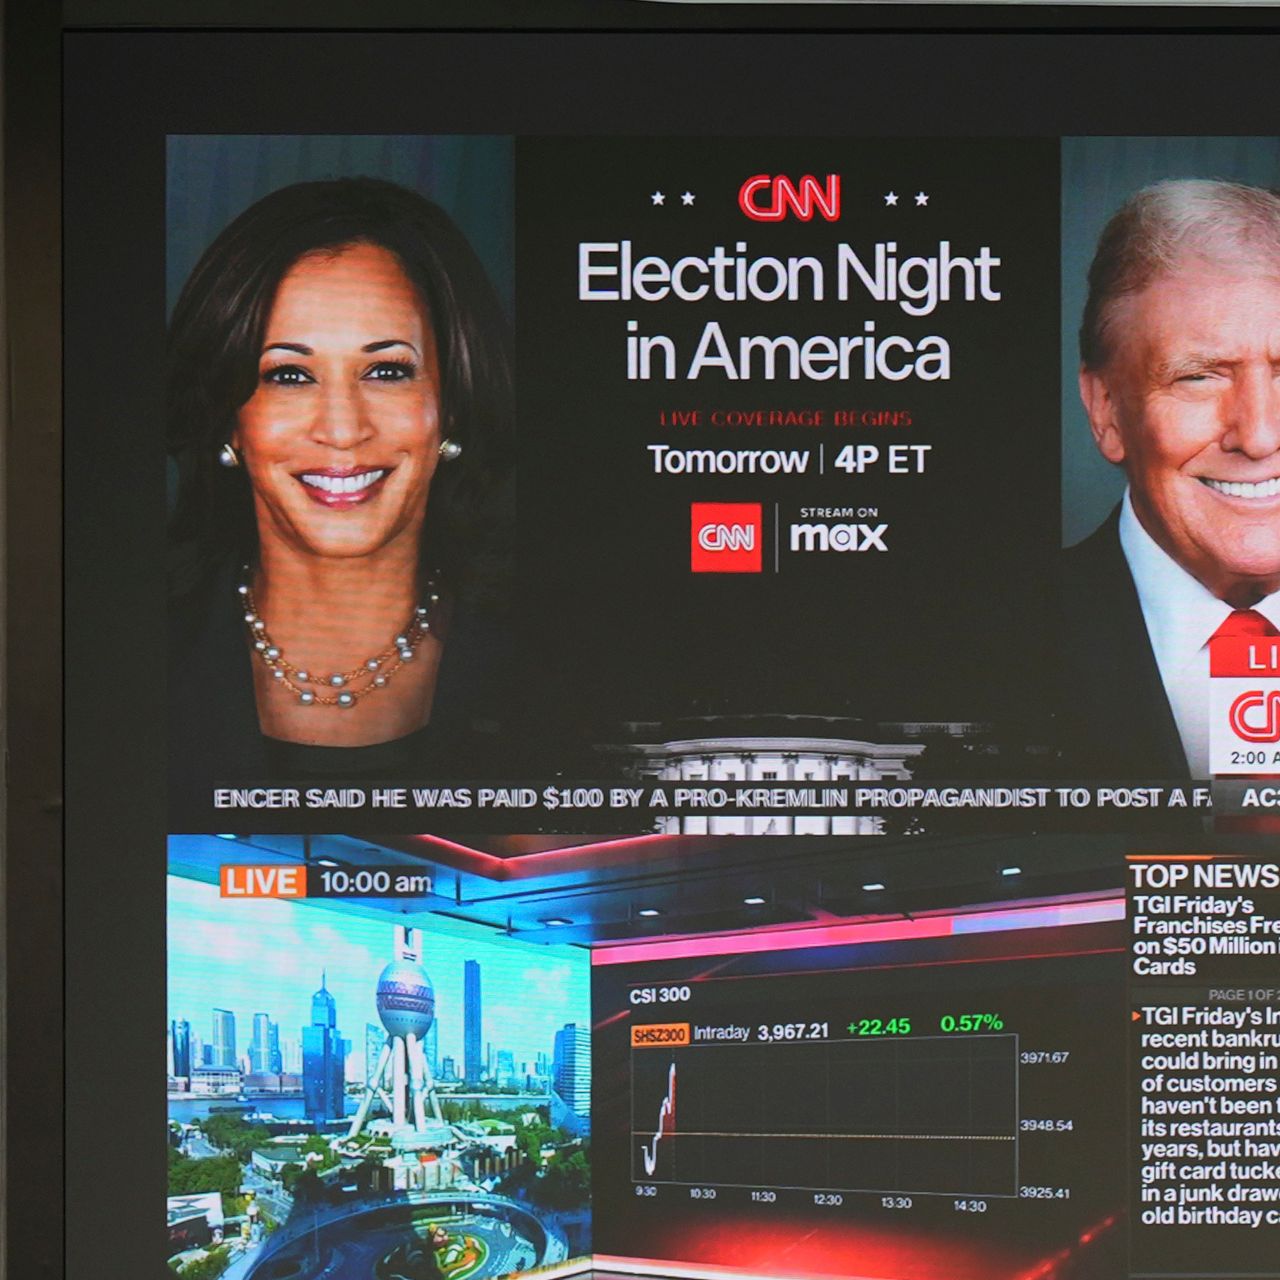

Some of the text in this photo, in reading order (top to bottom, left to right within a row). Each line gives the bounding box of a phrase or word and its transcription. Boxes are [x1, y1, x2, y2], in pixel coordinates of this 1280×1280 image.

[738, 173, 841, 222] CNN
[578, 239, 1002, 317] Election Night
[627, 320, 951, 382] in America
[646, 444, 932, 474] Tomorrow 4P ET
[697, 523, 755, 551] CNN
[790, 523, 889, 552] max
[1231, 750, 1266, 765] 2:00
[213, 785, 1188, 810] ENCER SAID HE WAS PAID $100 BY A PRO-KREMLIN PROPAGANDIST TO POST A
[227, 867, 434, 896] LIVE 10:00 am
[1128, 863, 1280, 888] TOP NEWS
[1132, 895, 1257, 919] TGI Friday's
[1133, 914, 1248, 935] Franchises
[1132, 940, 1161, 955] on
[1162, 936, 1207, 959] $50
[1208, 936, 1277, 955] Million
[1133, 956, 1197, 976] Cards
[629, 986, 691, 1005] CSI 300
[633, 1013, 1004, 1044] SHSZ300 Intraday 3,967.21 +22.45 0.57%
[1141, 1006, 1178, 1026] TGI
[1181, 1006, 1263, 1031] Friday's
[1141, 1030, 1210, 1048] recent
[1141, 1051, 1200, 1070] could
[1202, 1051, 1256, 1074] bring
[1259, 1051, 1278, 1070] in
[1141, 1073, 1164, 1093] of
[1166, 1074, 1278, 1093] customers
[1141, 1095, 1217, 1115] haven't
[1220, 1095, 1273, 1115] been
[1141, 1118, 1168, 1137] its
[1141, 1143, 1204, 1161] years,
[1206, 1138, 1242, 1158] but
[1141, 1161, 1177, 1184] gift
[1179, 1161, 1226, 1180] card
[1141, 1183, 1161, 1202] in
[1163, 1188, 1179, 1204] a
[1178, 1183, 1225, 1208] junk
[1141, 1205, 1175, 1225] old
[1177, 1205, 1263, 1229] birthday
